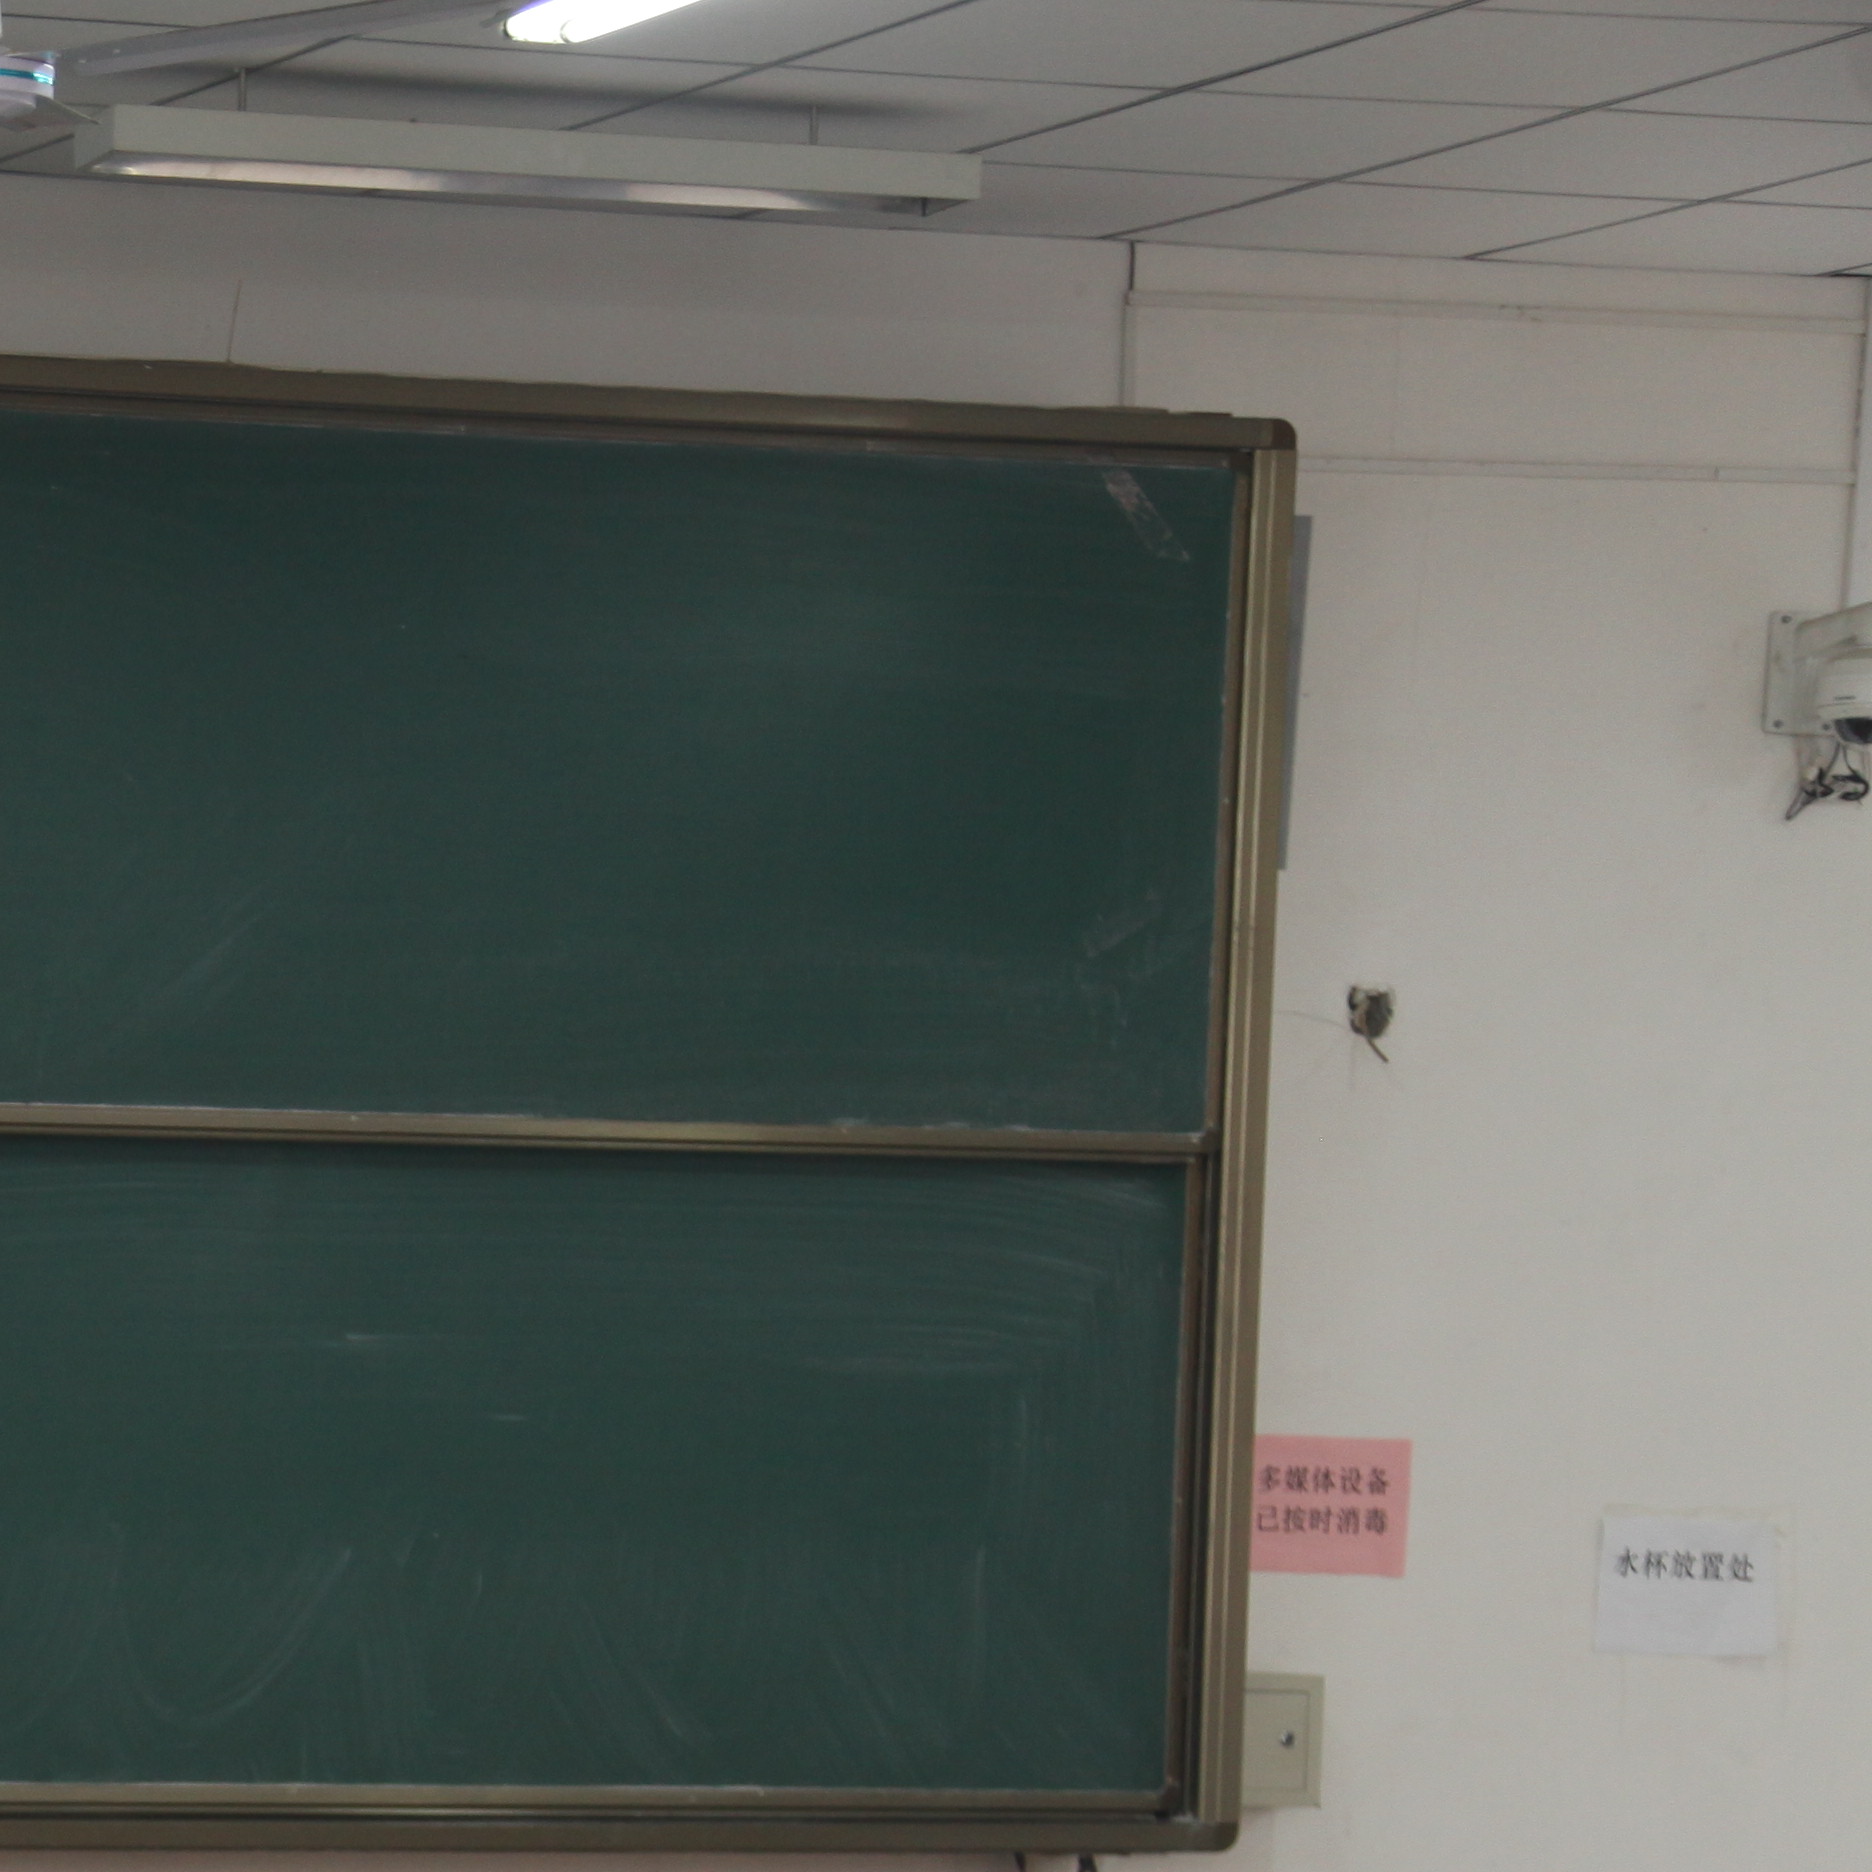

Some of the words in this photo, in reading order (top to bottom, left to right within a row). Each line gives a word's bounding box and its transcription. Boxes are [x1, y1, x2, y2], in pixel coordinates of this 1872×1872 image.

[1257, 1465, 1391, 1497] 多媒体设备
[1257, 1505, 1389, 1537] 已按时消毒
[1614, 1545, 1755, 1584] 水杯放置处
